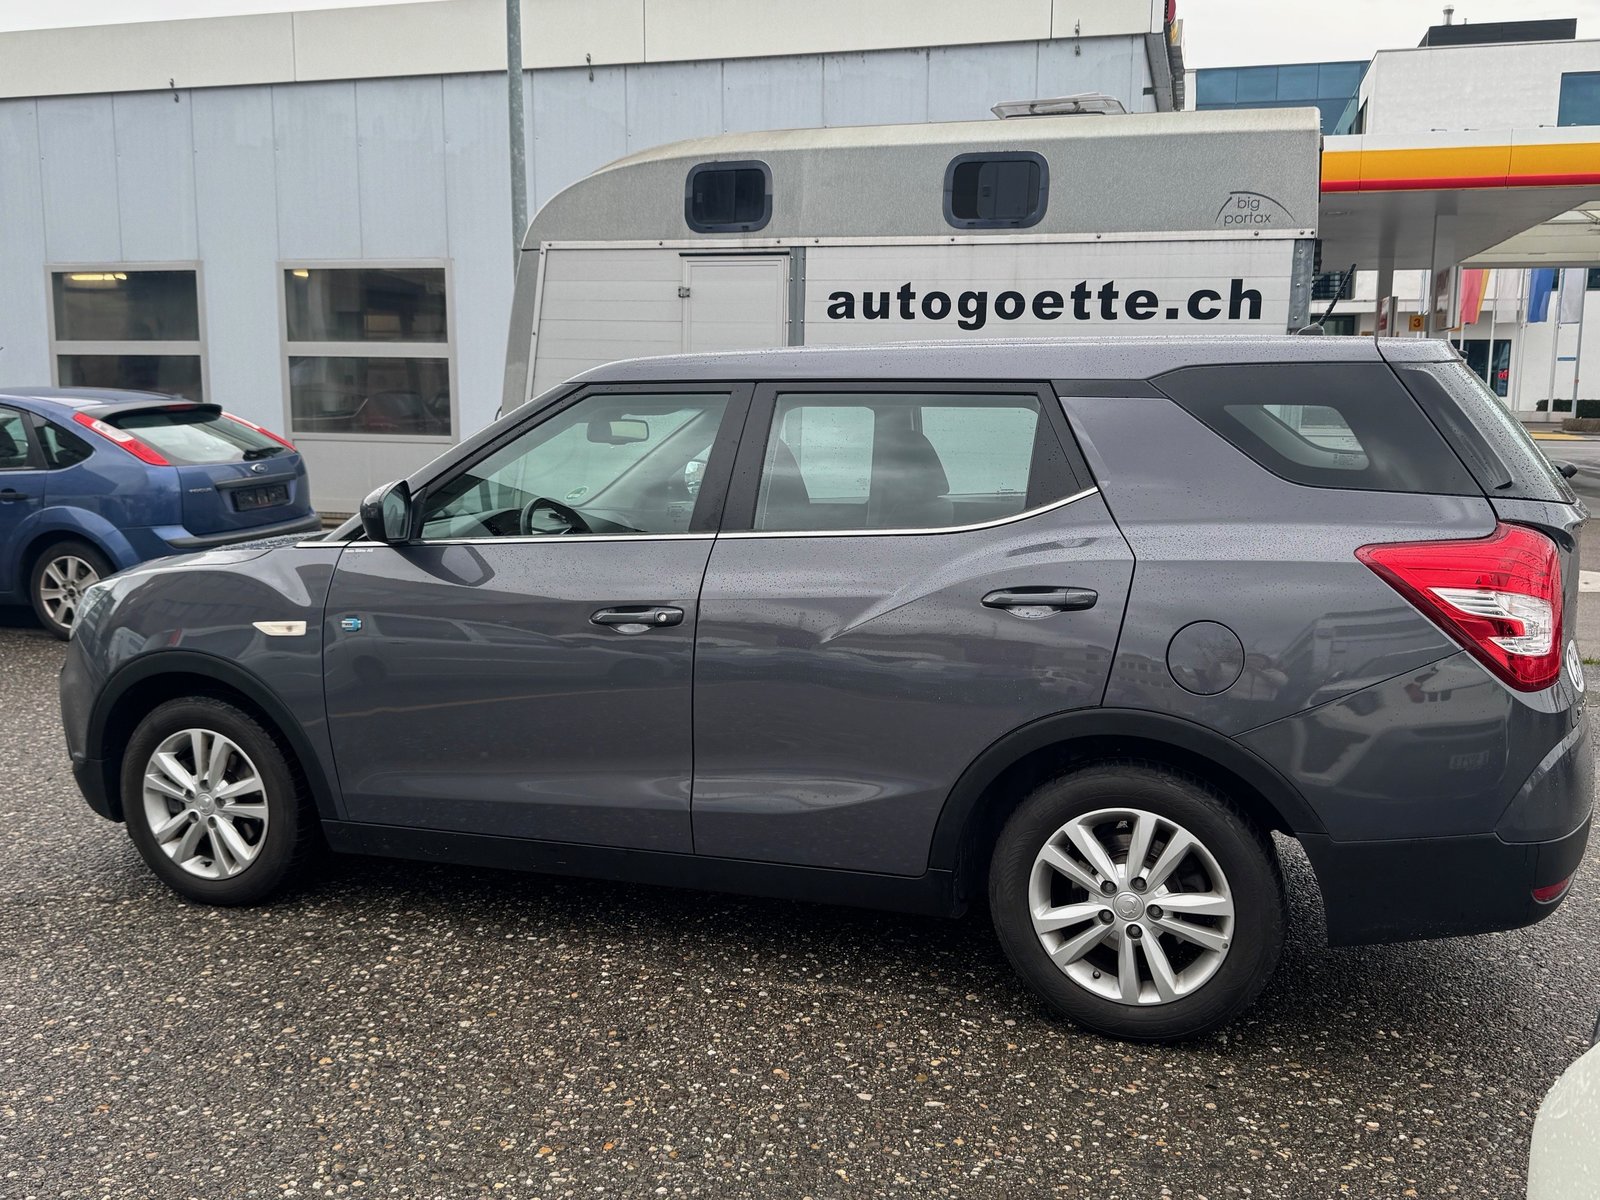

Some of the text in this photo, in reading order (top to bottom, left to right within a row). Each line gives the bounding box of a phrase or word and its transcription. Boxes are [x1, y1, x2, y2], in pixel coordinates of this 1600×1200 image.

[1237, 197, 1260, 211] big
[1224, 212, 1271, 226] portax
[827, 279, 1263, 330] autogoette.ch
[1413, 318, 1421, 328] 3
